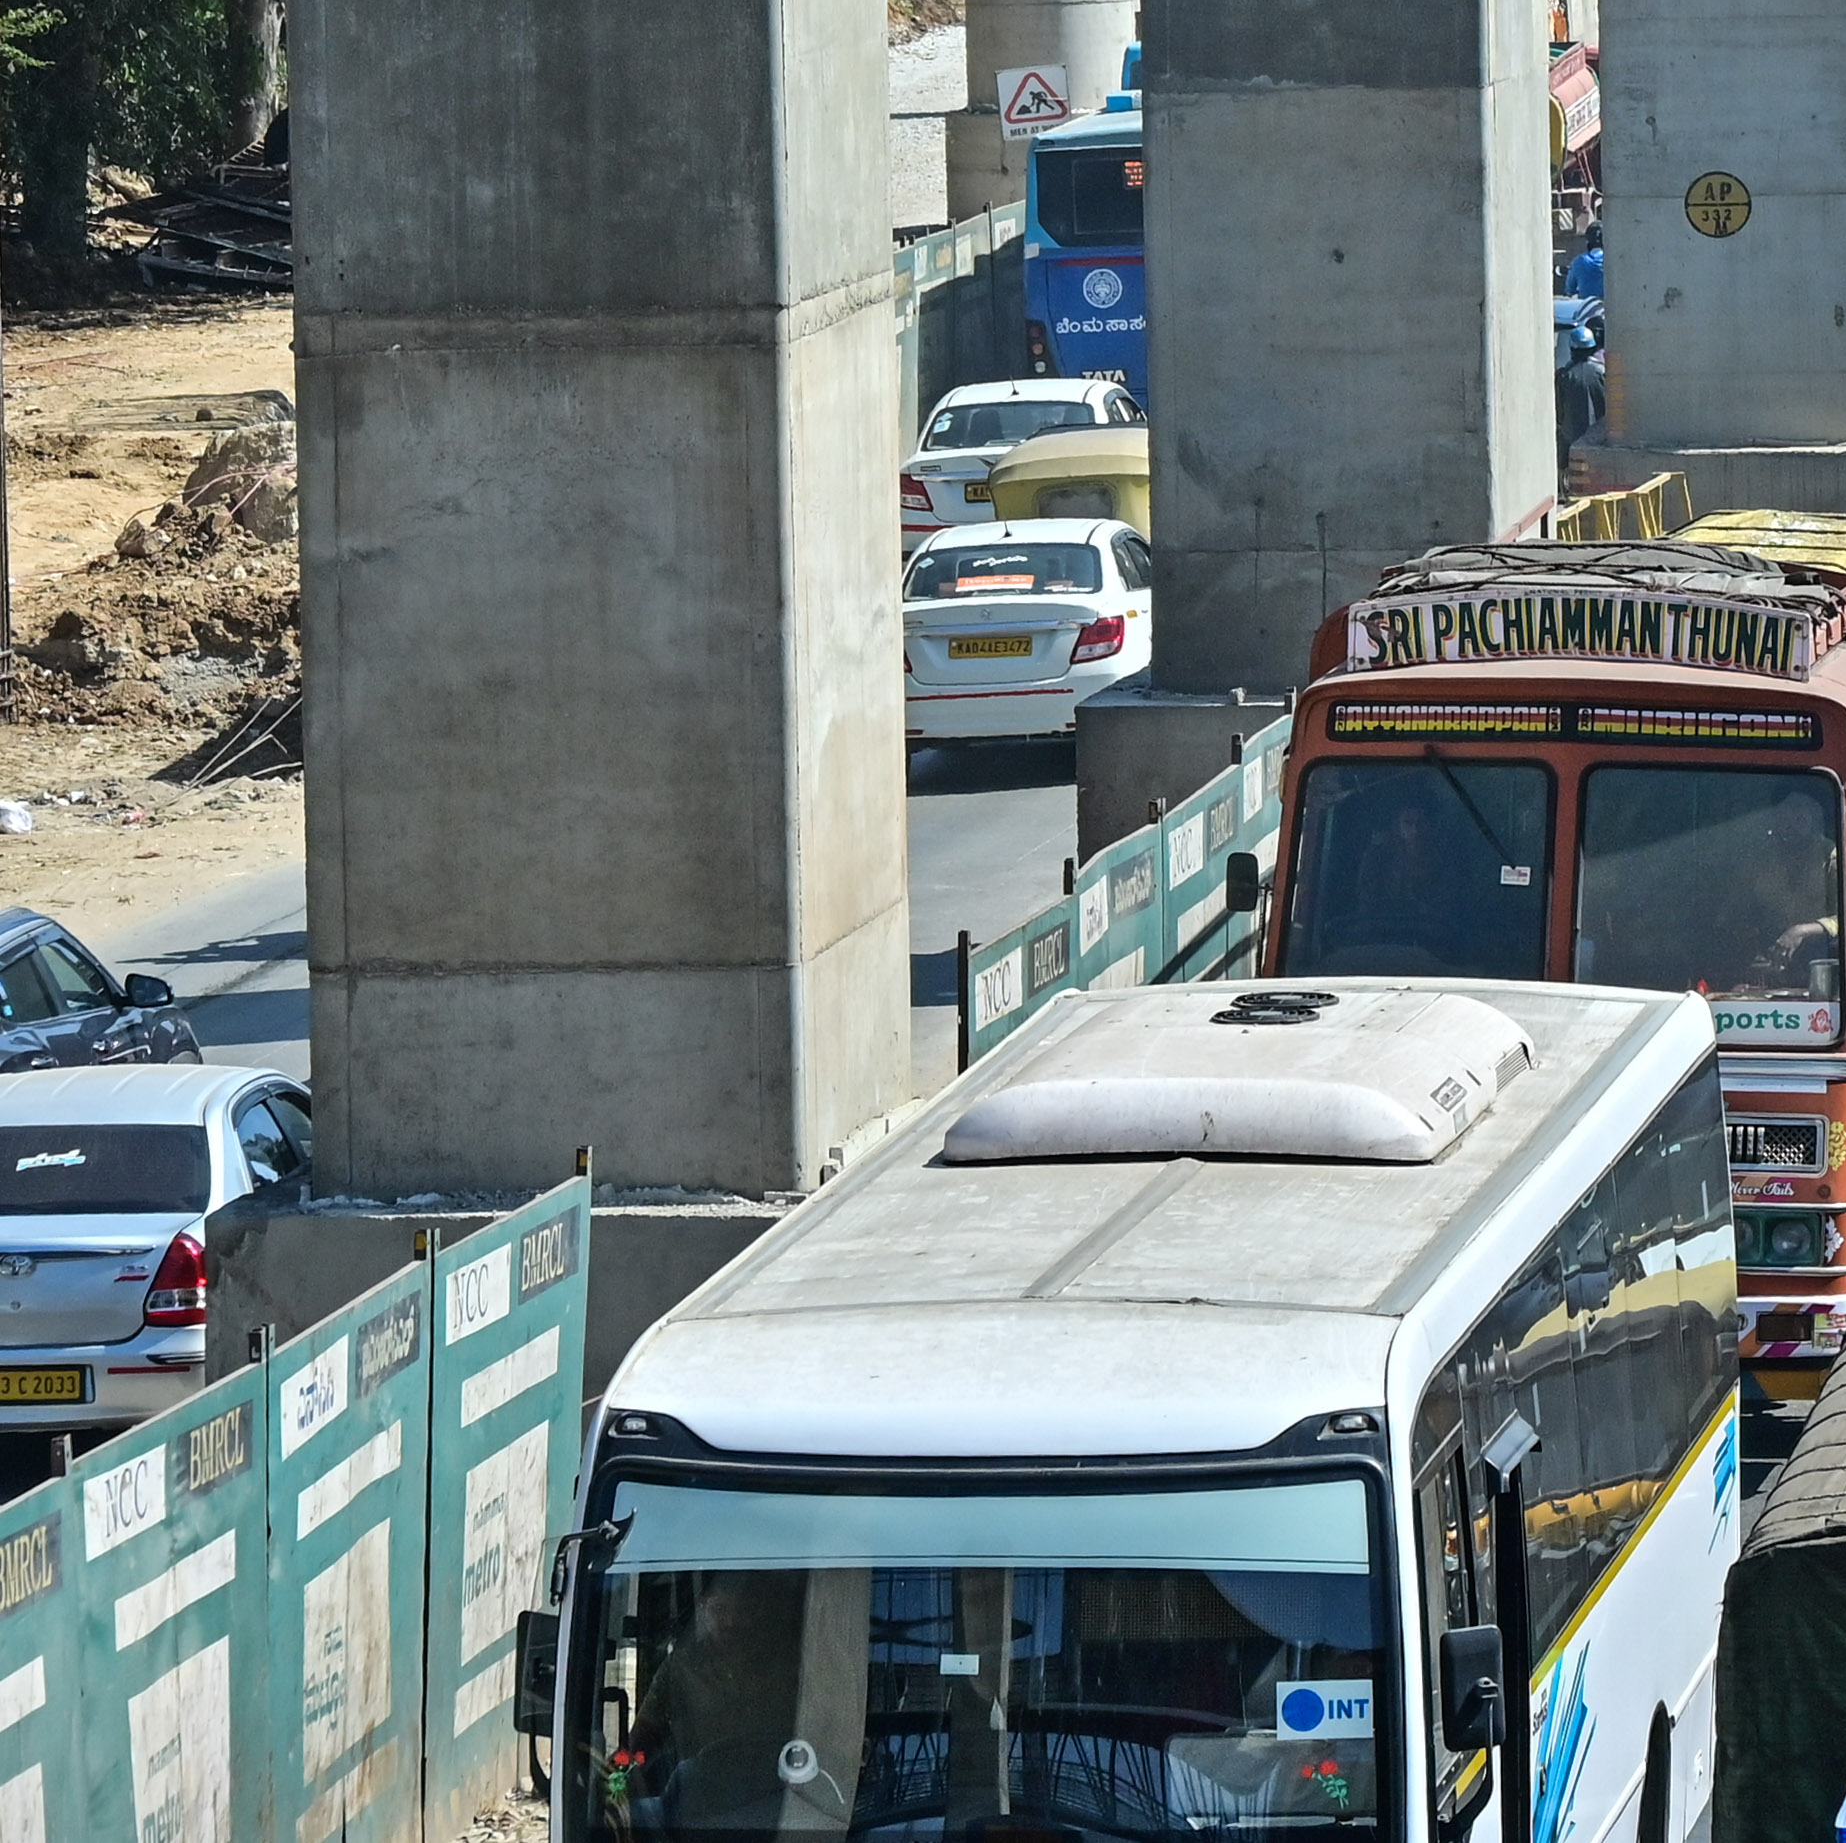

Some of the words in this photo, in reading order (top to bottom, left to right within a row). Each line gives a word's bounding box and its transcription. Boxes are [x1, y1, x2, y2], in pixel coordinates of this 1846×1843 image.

[1010, 128, 1028, 137] MEN
[1030, 127, 1041, 135] AT
[1702, 209, 1732, 222] 332
[1704, 182, 1732, 201] AP
[1082, 369, 1126, 382] TATA
[1365, 603, 1424, 667] SRI
[1667, 604, 1796, 673] THUNAI
[1346, 705, 1547, 732] AYYANARAPPAN
[1209, 796, 1235, 848] BMRCL
[1173, 827, 1194, 879] NCC
[1033, 929, 1066, 990] BMRCL
[984, 959, 1012, 1016] NCC
[1715, 1009, 1801, 1034] ports
[521, 1222, 566, 1292] BMRCL
[453, 1263, 489, 1330] NCC
[0, 1379, 10, 1394] 3
[18, 1379, 28, 1394] C
[33, 1377, 77, 1394] 2033
[189, 1407, 244, 1491] BMRCL
[104, 1460, 148, 1538] NCC
[463, 1539, 501, 1608] metro
[1328, 1698, 1370, 1720] INT
